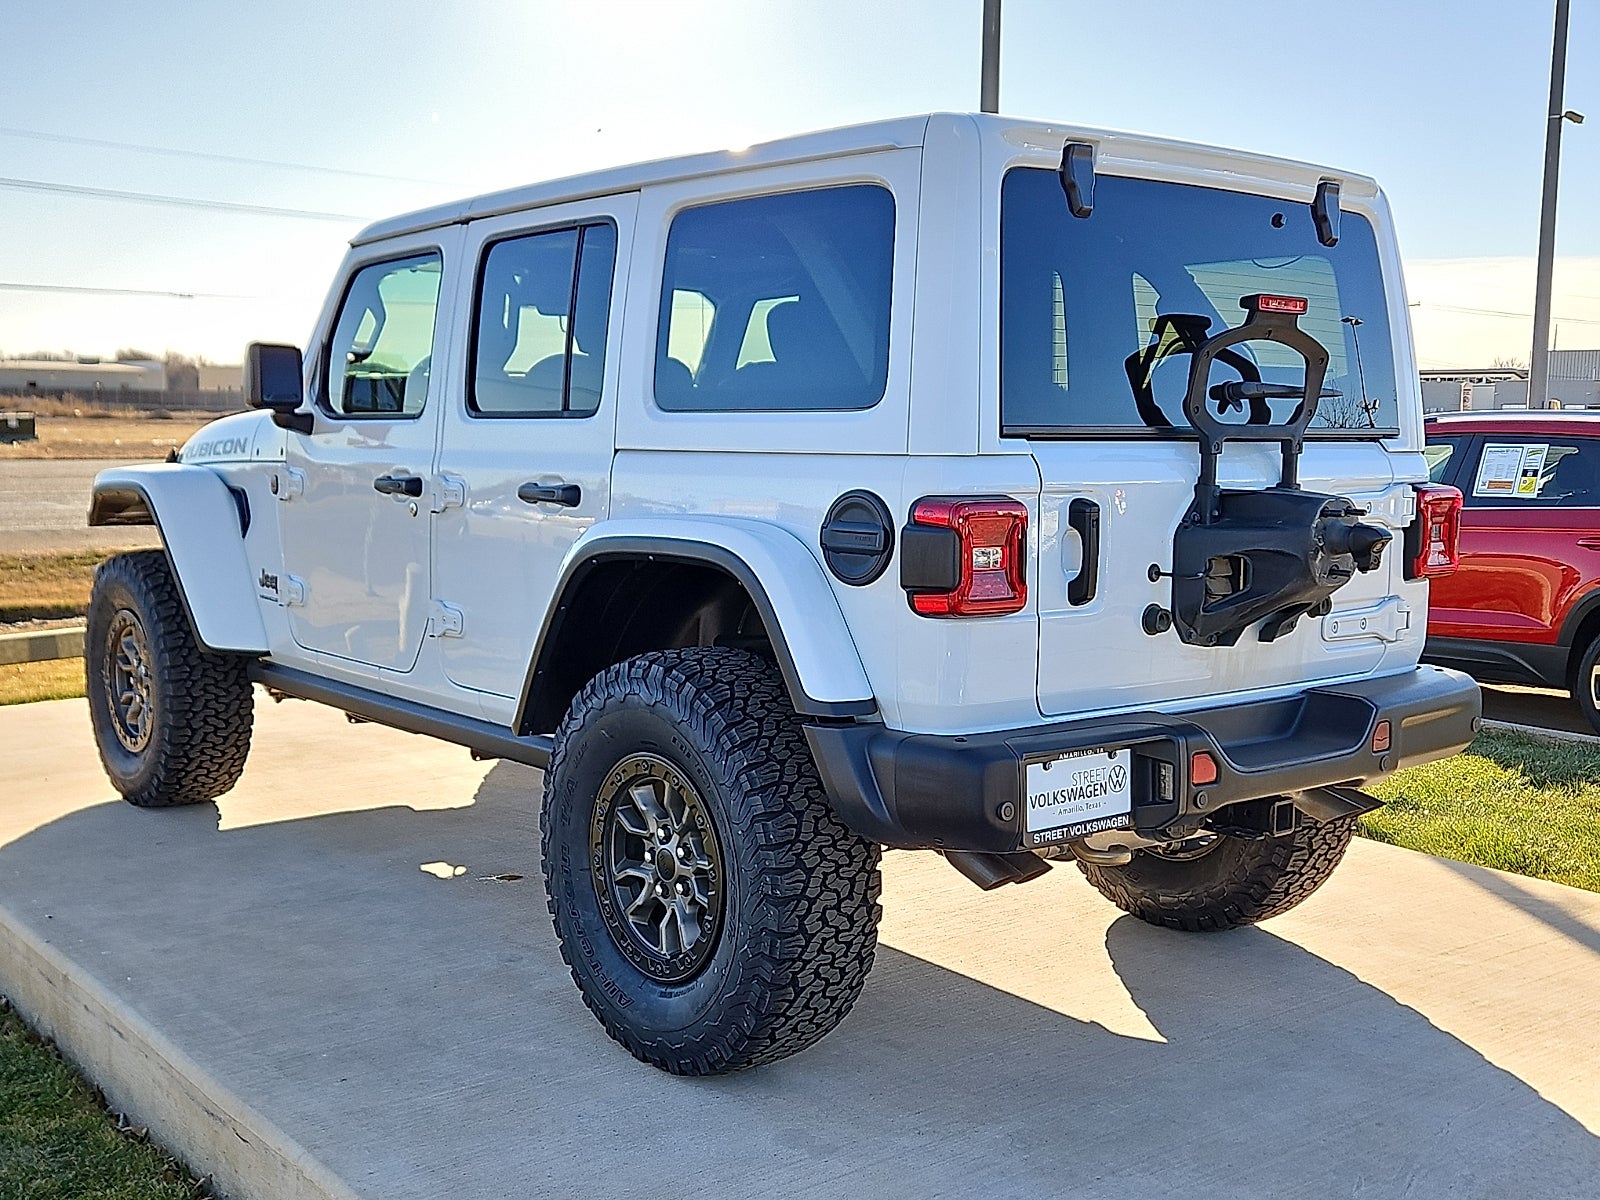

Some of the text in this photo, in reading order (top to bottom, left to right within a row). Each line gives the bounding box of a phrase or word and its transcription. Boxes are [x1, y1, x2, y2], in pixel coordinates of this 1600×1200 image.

[258, 568, 279, 595] Jeep
[1071, 767, 1107, 787] STREET
[1029, 781, 1108, 810] VOLKSWAGEN
[1086, 801, 1102, 810] Texas
[1033, 814, 1129, 844] STREET VOLKSWAGEN
